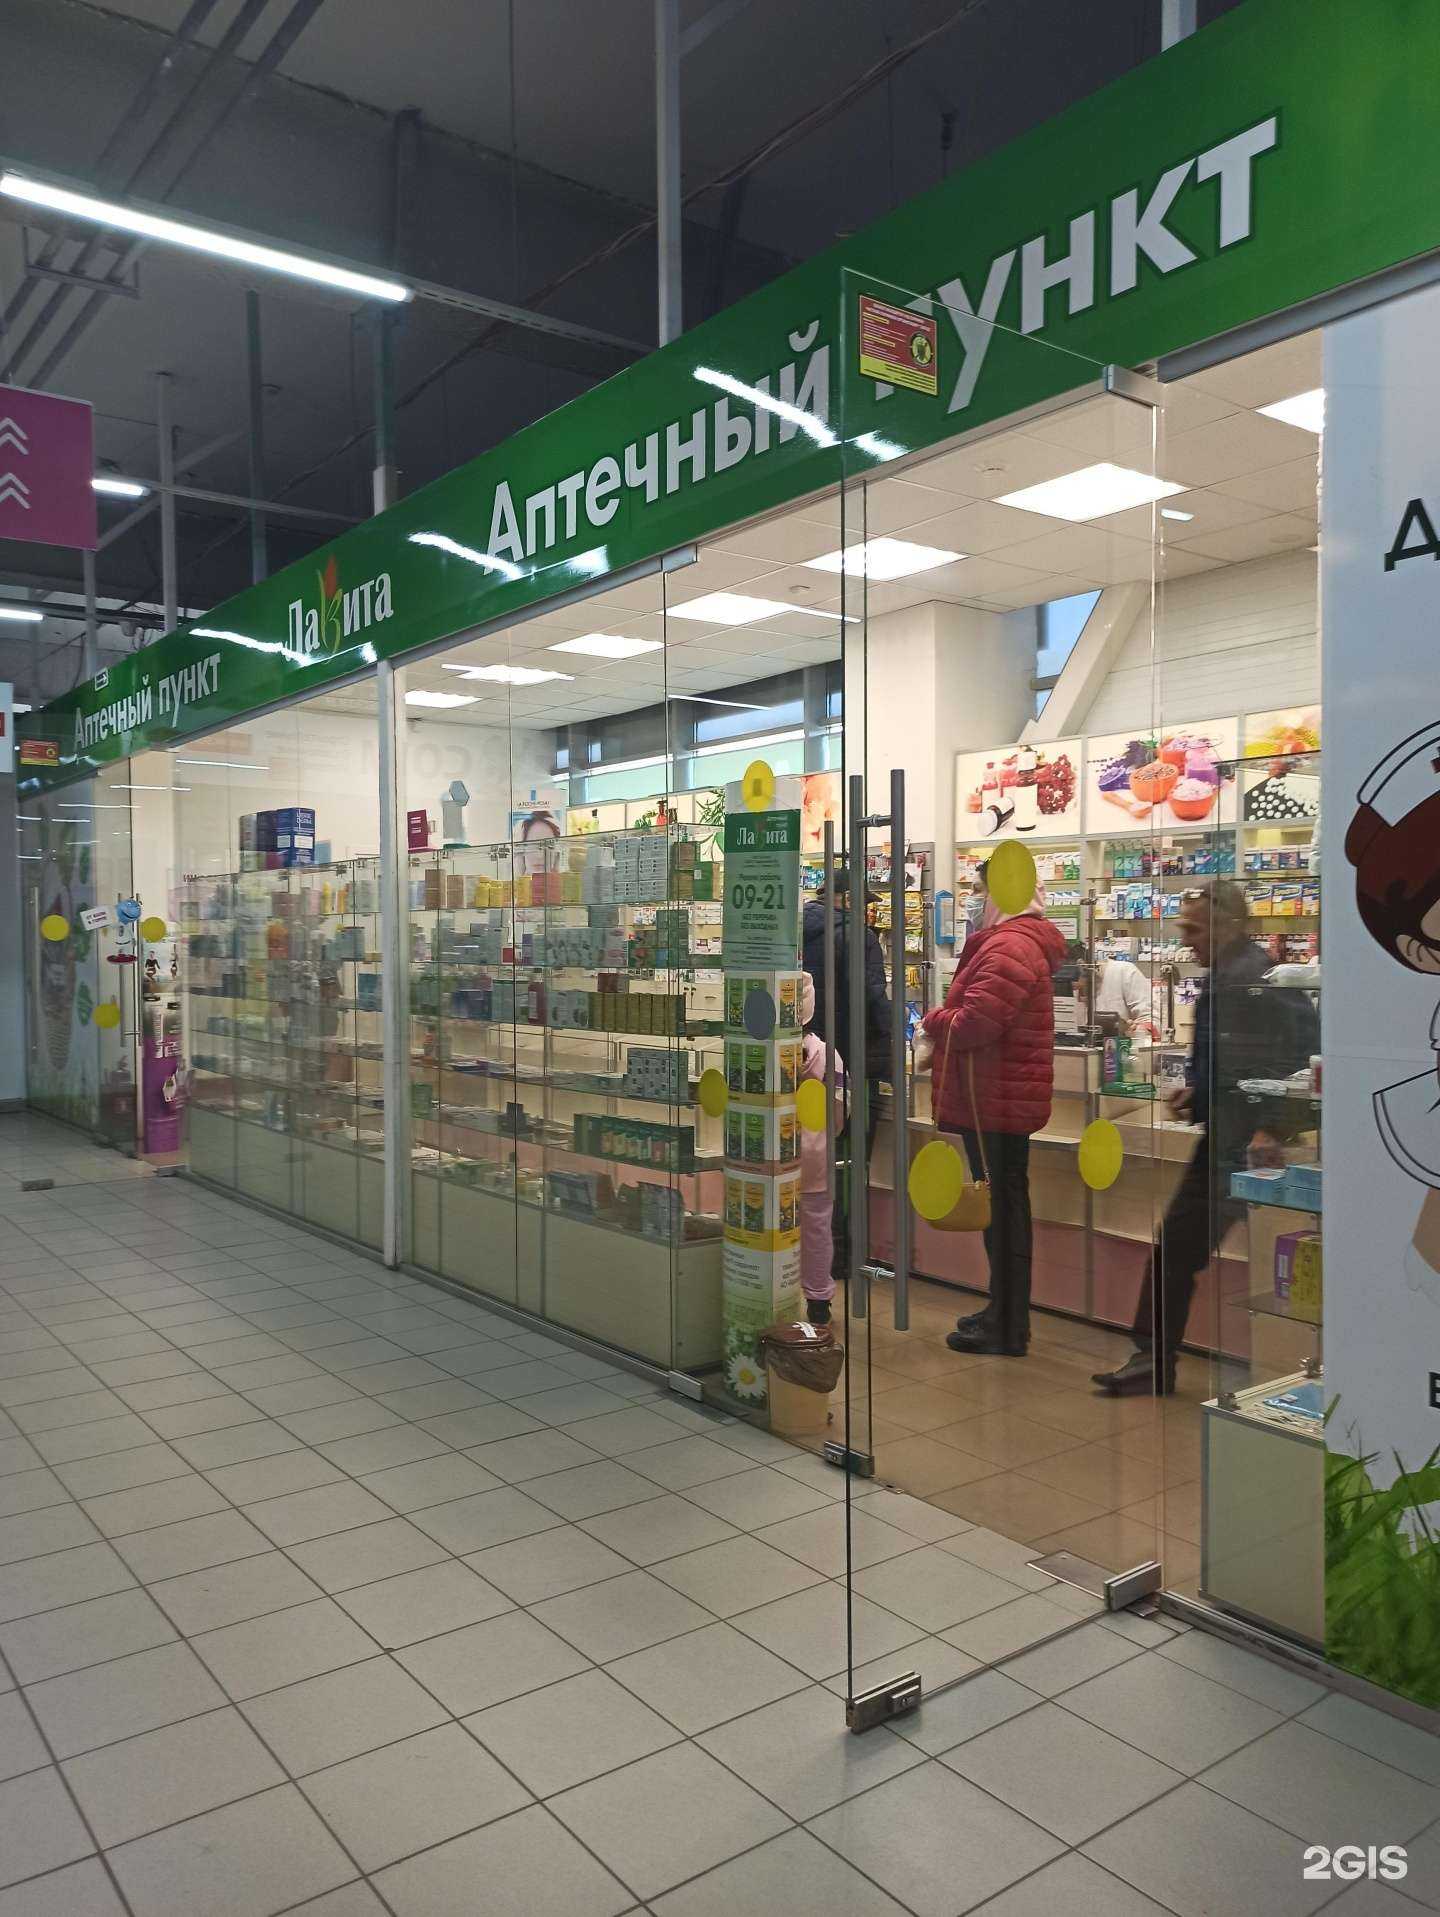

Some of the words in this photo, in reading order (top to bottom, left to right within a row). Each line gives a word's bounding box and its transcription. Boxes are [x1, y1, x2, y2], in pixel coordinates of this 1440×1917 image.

[484, 320, 830, 575] Аптечный
[874, 116, 1277, 414] ункт
[74, 673, 152, 754] Аптечный
[158, 652, 221, 728] пункт
[732, 884, 785, 909] 09-21
